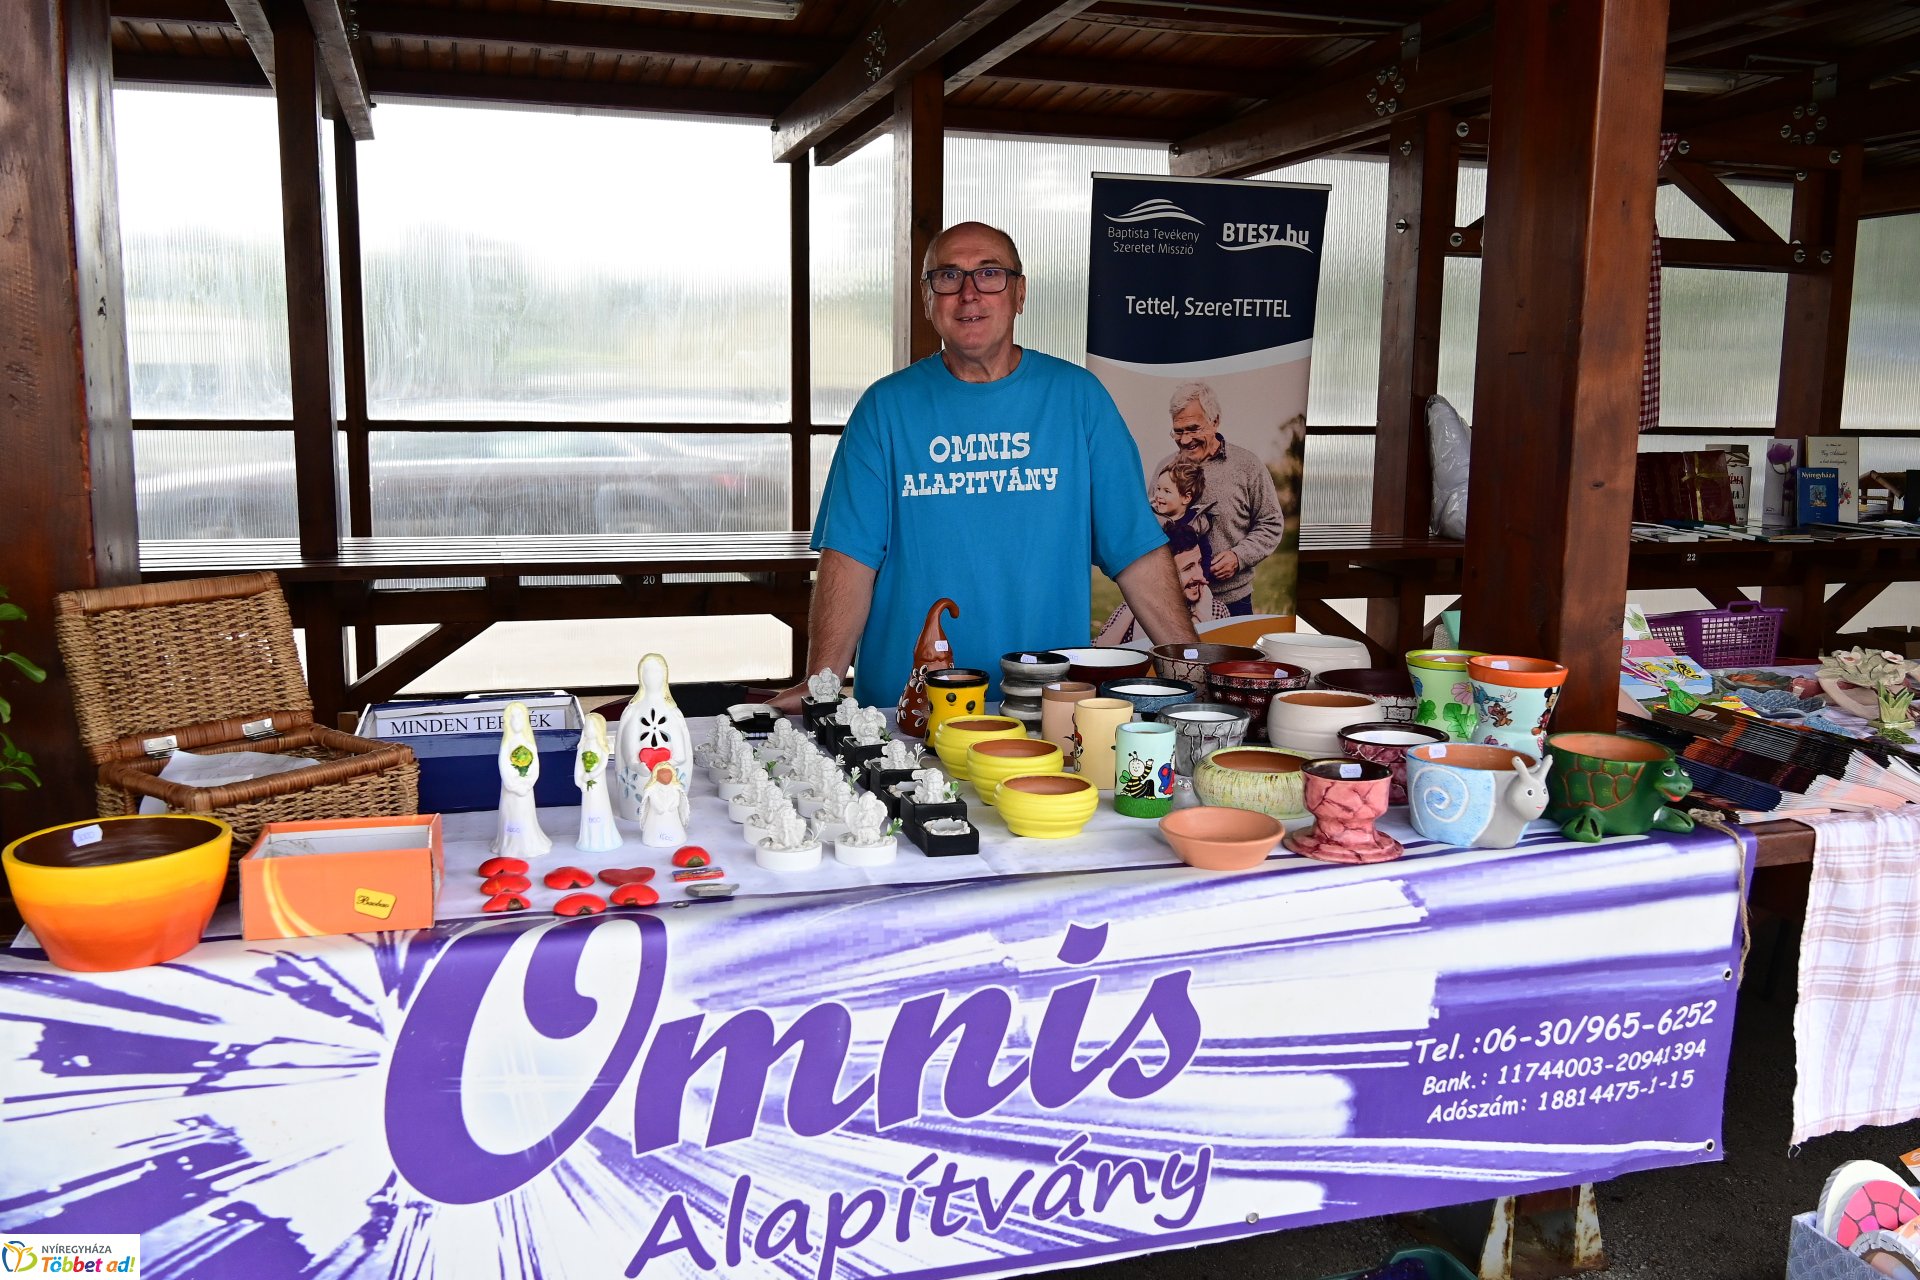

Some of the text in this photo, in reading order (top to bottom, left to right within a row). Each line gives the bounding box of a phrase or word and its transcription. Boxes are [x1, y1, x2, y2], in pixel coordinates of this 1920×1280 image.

[1107, 226, 1200, 243] Baptista Tevékeny
[1222, 222, 1310, 245] BTESZ.hu
[1113, 241, 1194, 255] Szeretet Misszió
[1125, 296, 1291, 318] Tettel, SzereTETTEL
[929, 432, 1031, 463] OMNIS
[902, 466, 1059, 497] ALAPITVÁNY
[1686, 553, 1696, 562] 22
[642, 575, 656, 585] 20
[391, 717, 468, 735] MINDEN
[384, 912, 1201, 1205] Omnis
[1497, 1038, 1707, 1085] 11744003-20941394
[1426, 1068, 1695, 1124] Adószám: 18814475-1-15
[624, 1134, 1214, 1280] Alapítvány
